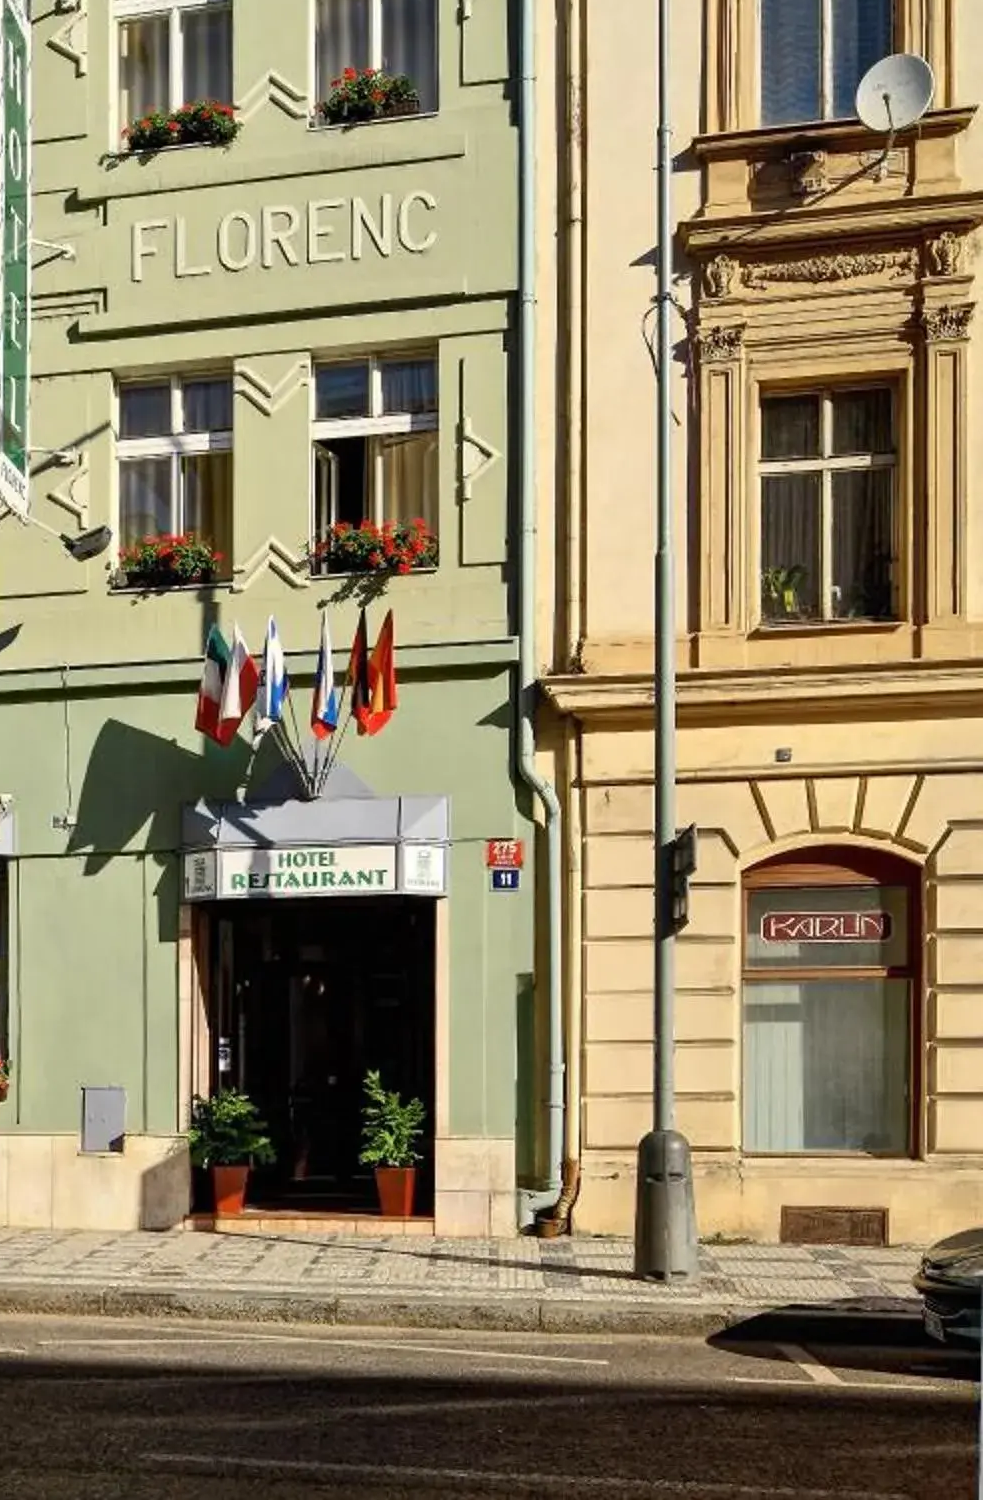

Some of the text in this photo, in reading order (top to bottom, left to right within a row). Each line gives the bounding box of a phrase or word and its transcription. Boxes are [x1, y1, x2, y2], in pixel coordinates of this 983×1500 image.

[8, 39, 23, 432] HOTEL
[131, 190, 438, 282] FLORENC
[278, 851, 337, 867] HOTEL
[231, 869, 388, 889] RESTAURANT
[501, 873, 512, 886] 11
